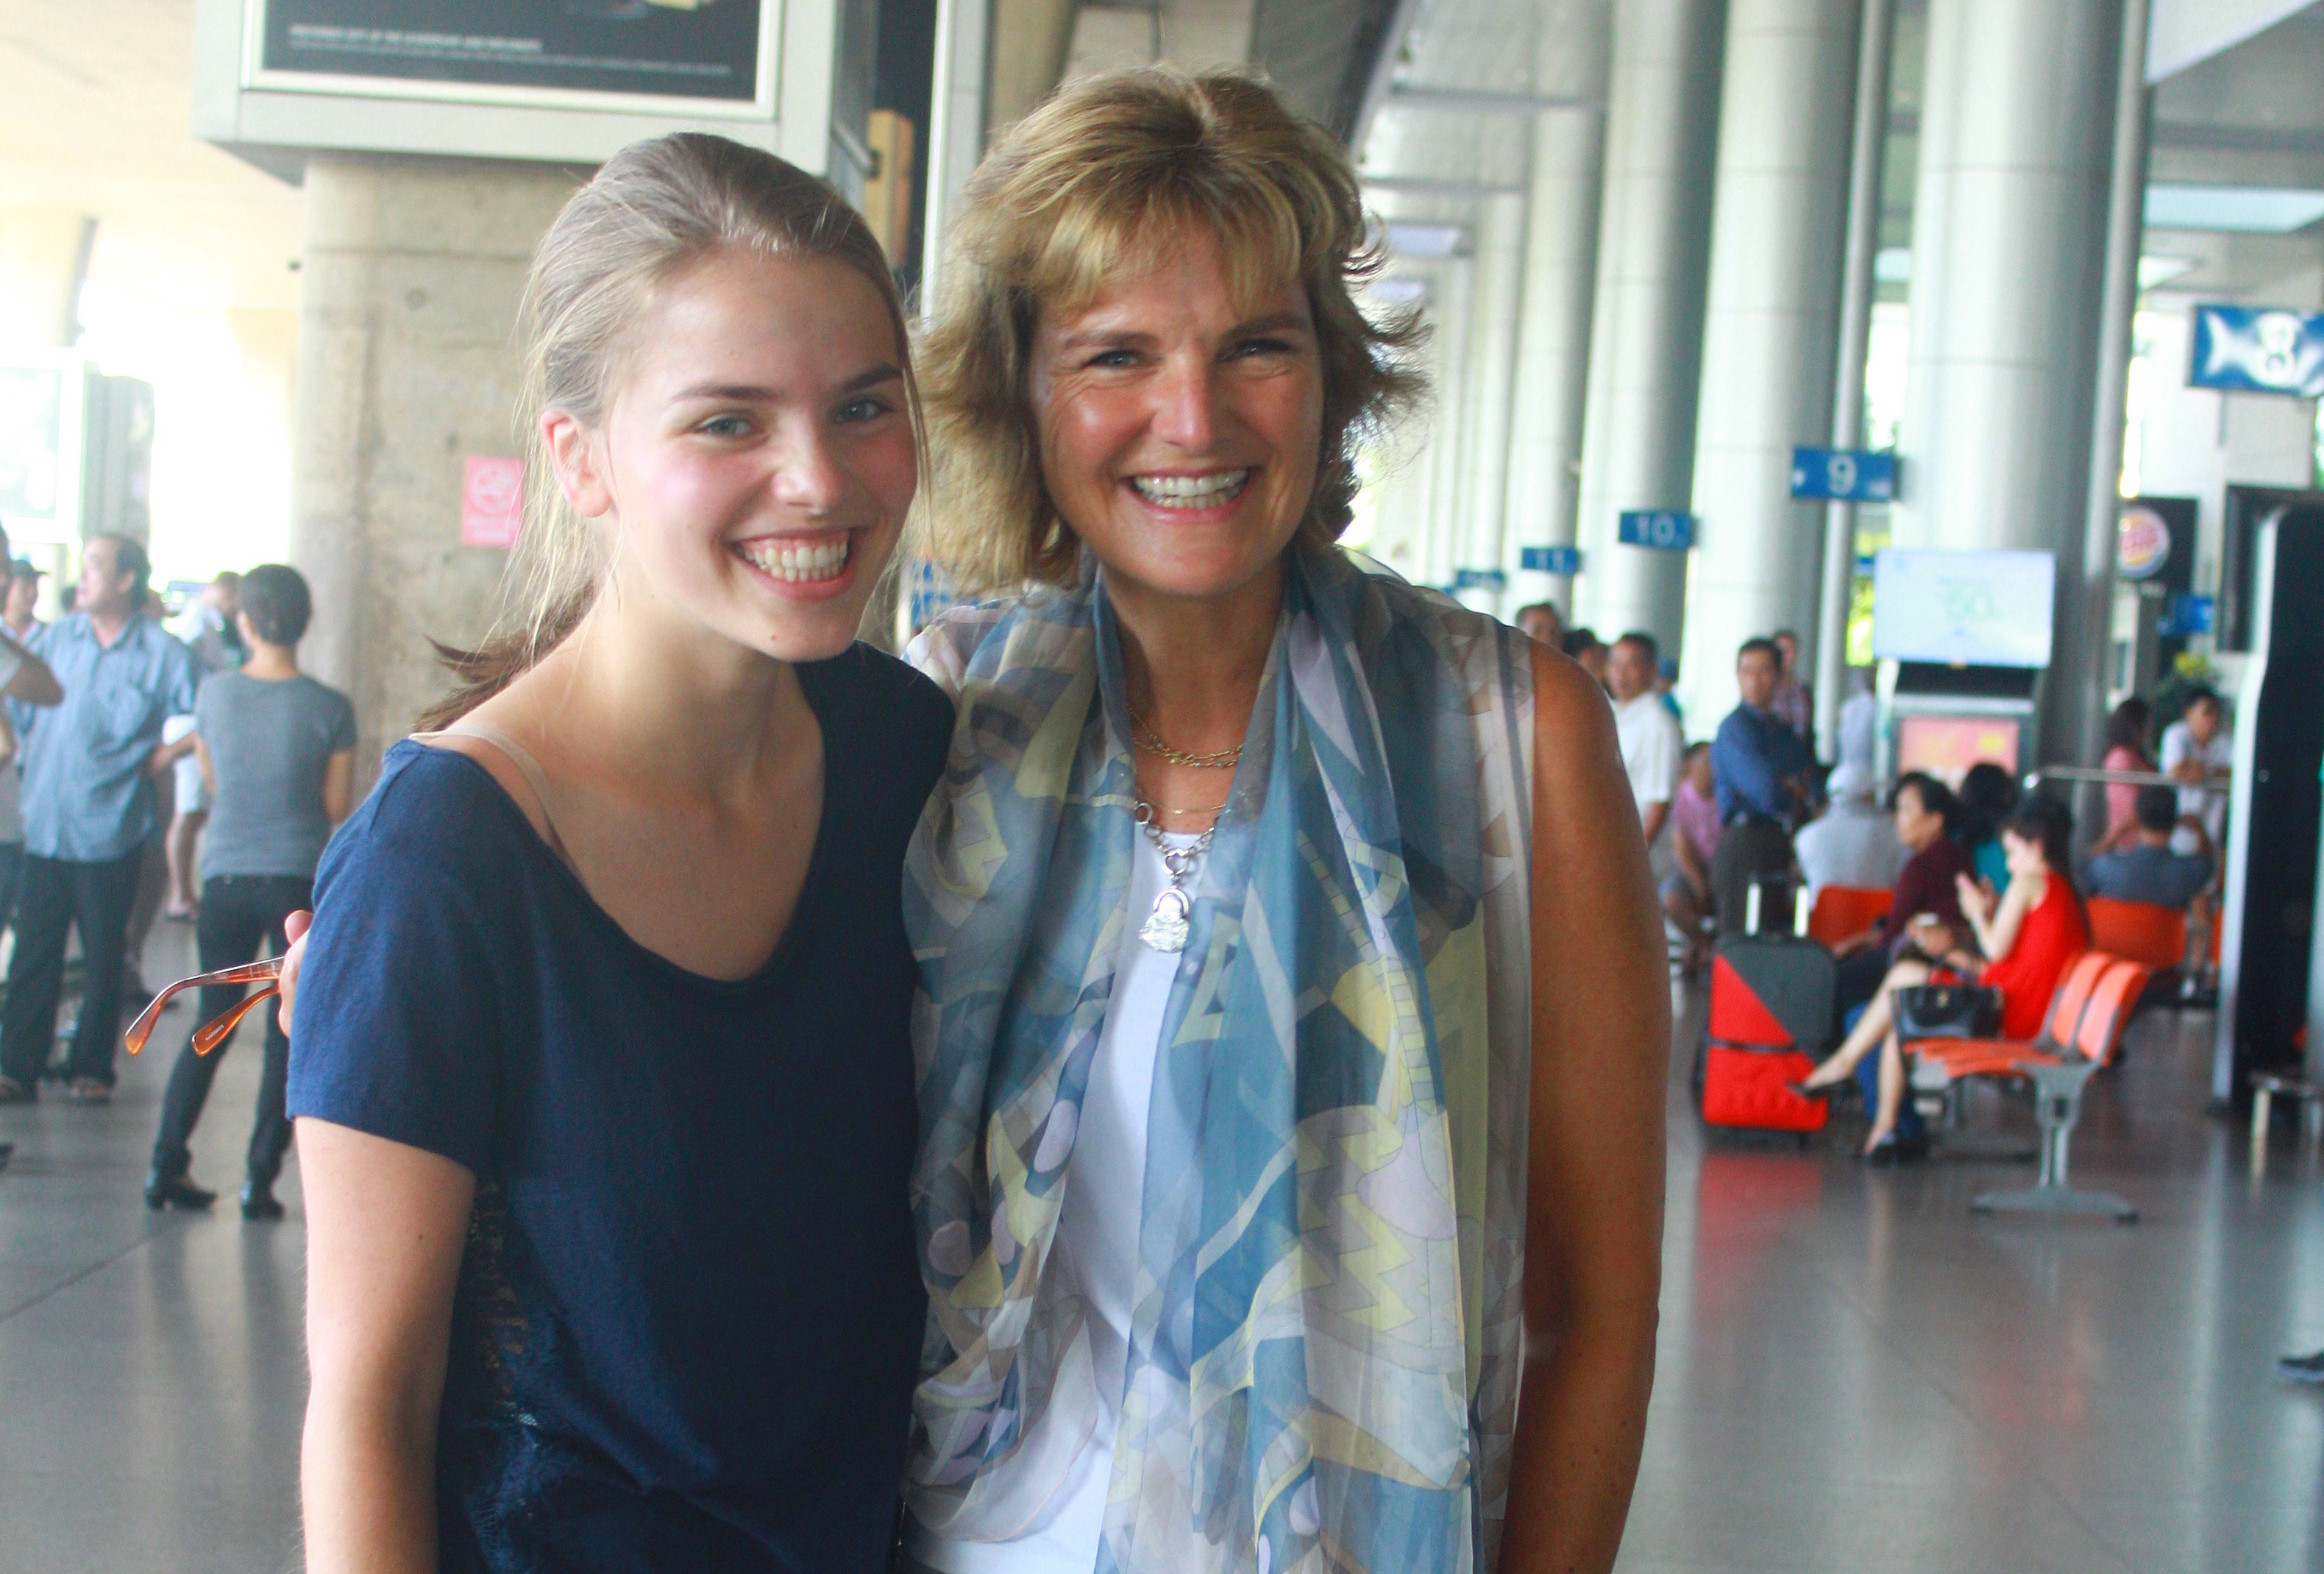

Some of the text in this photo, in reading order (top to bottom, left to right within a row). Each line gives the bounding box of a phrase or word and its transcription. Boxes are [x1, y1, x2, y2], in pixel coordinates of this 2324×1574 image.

[2254, 312, 2295, 385] 8
[1827, 453, 1857, 497] 9
[1636, 514, 1675, 546] 10
